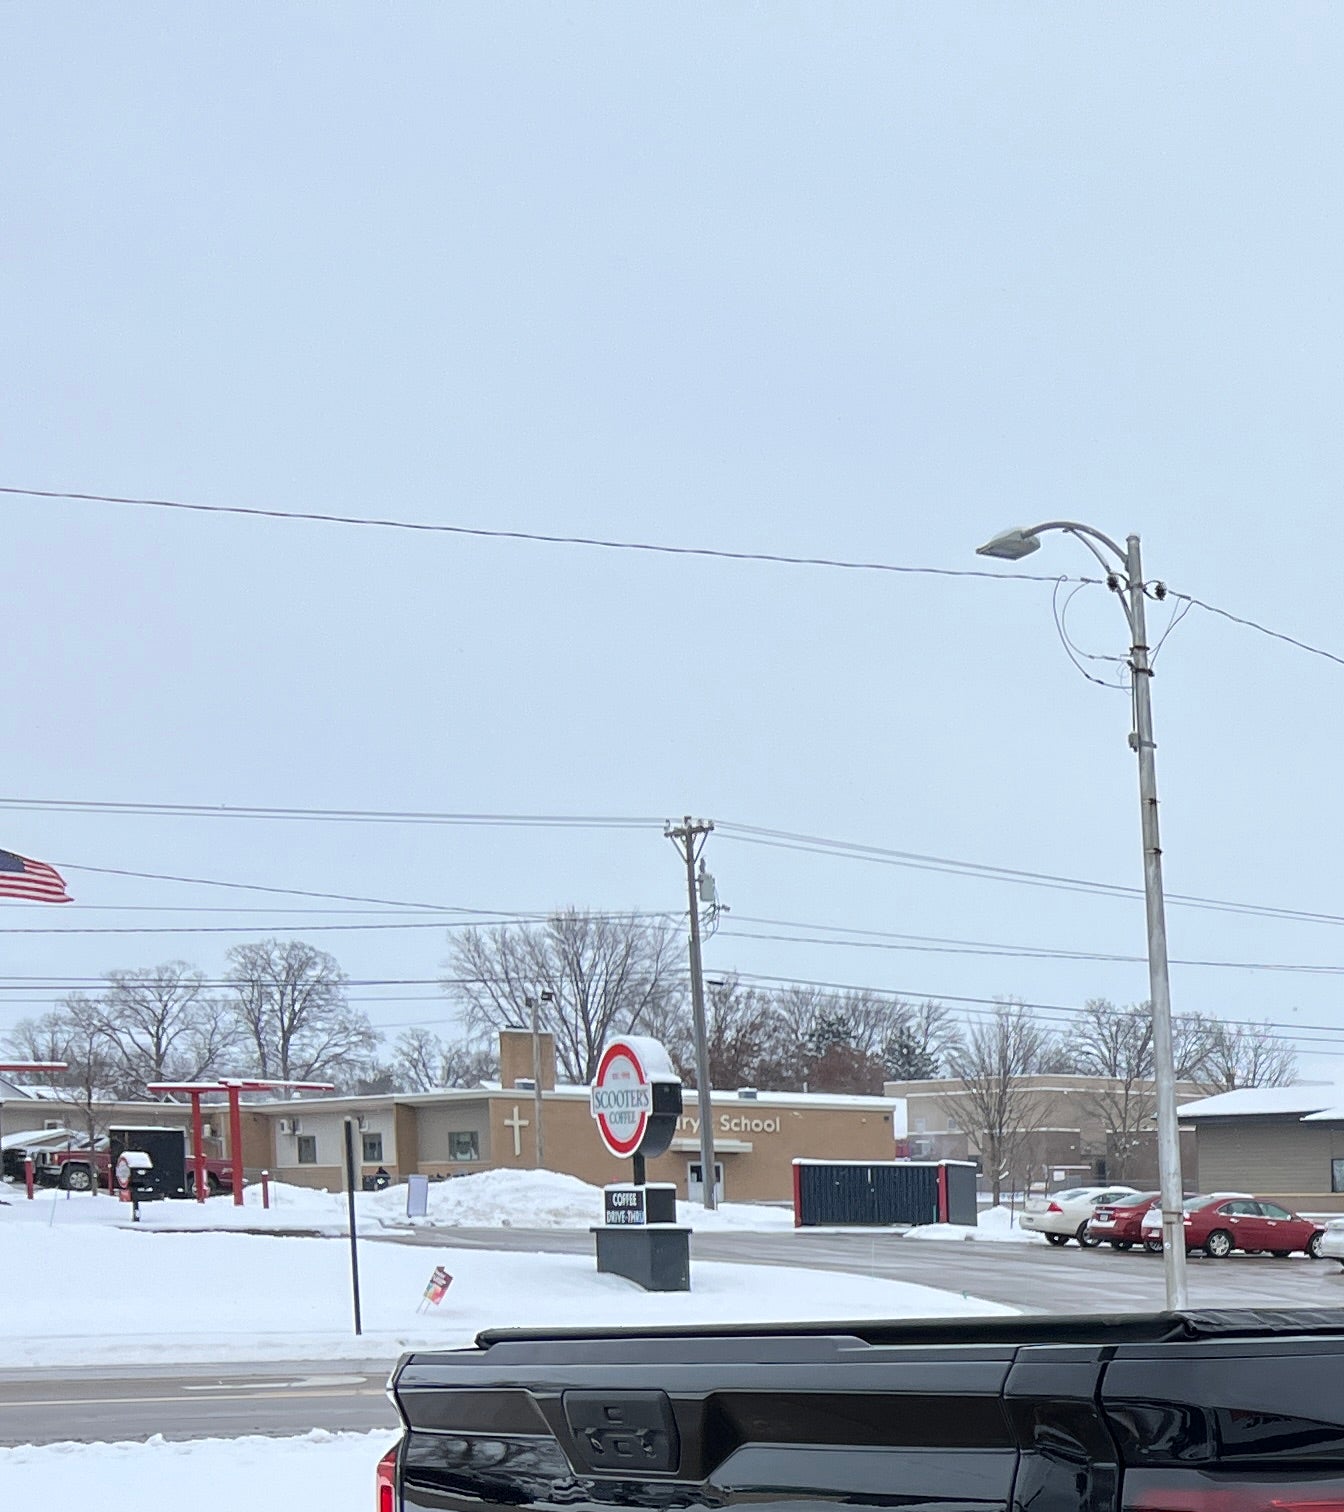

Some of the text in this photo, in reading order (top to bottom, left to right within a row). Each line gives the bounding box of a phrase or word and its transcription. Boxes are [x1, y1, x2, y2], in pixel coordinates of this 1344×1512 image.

[609, 1111, 636, 1124] COFFEE
[720, 1114, 780, 1132] School
[612, 1192, 637, 1207] COFFEE
